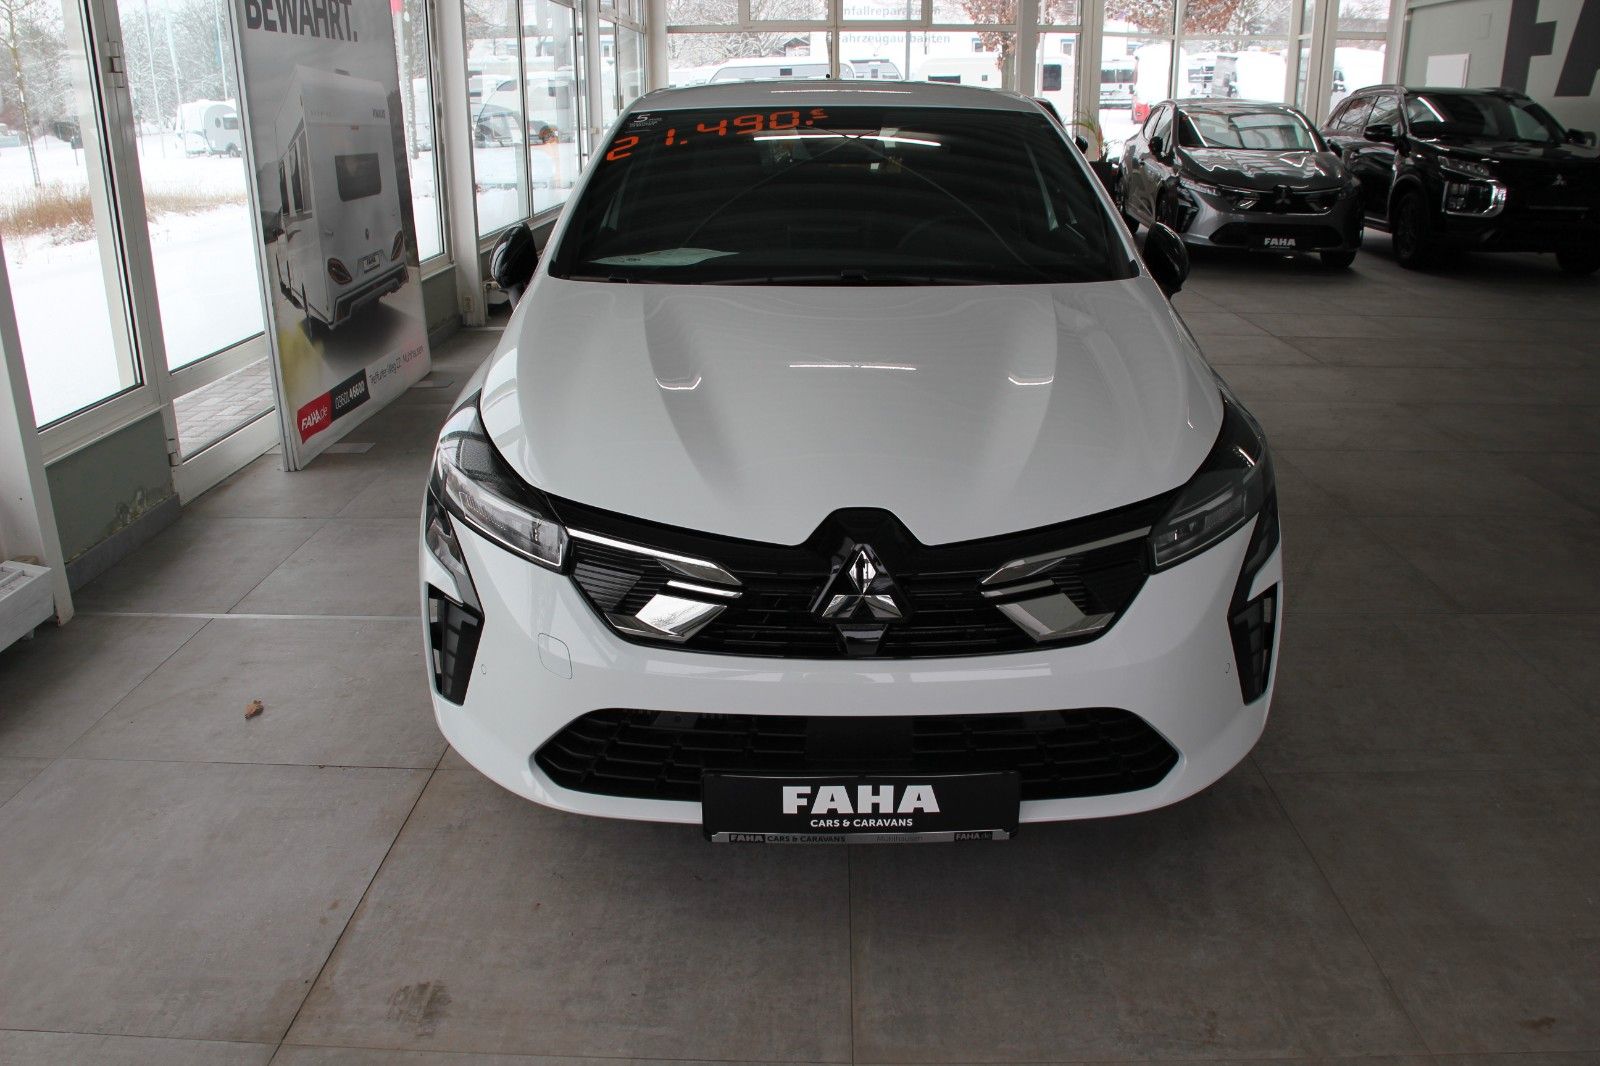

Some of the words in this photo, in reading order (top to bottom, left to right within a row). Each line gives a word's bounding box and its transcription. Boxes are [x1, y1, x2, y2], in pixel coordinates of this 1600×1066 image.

[1264, 237, 1296, 246] FAHA
[782, 785, 941, 814] FAHA
[810, 819, 840, 828] CARS
[842, 819, 851, 827] &
[853, 818, 913, 827] CARAVANS
[730, 834, 764, 842] FAHA
[800, 835, 846, 843] CARAVANS
